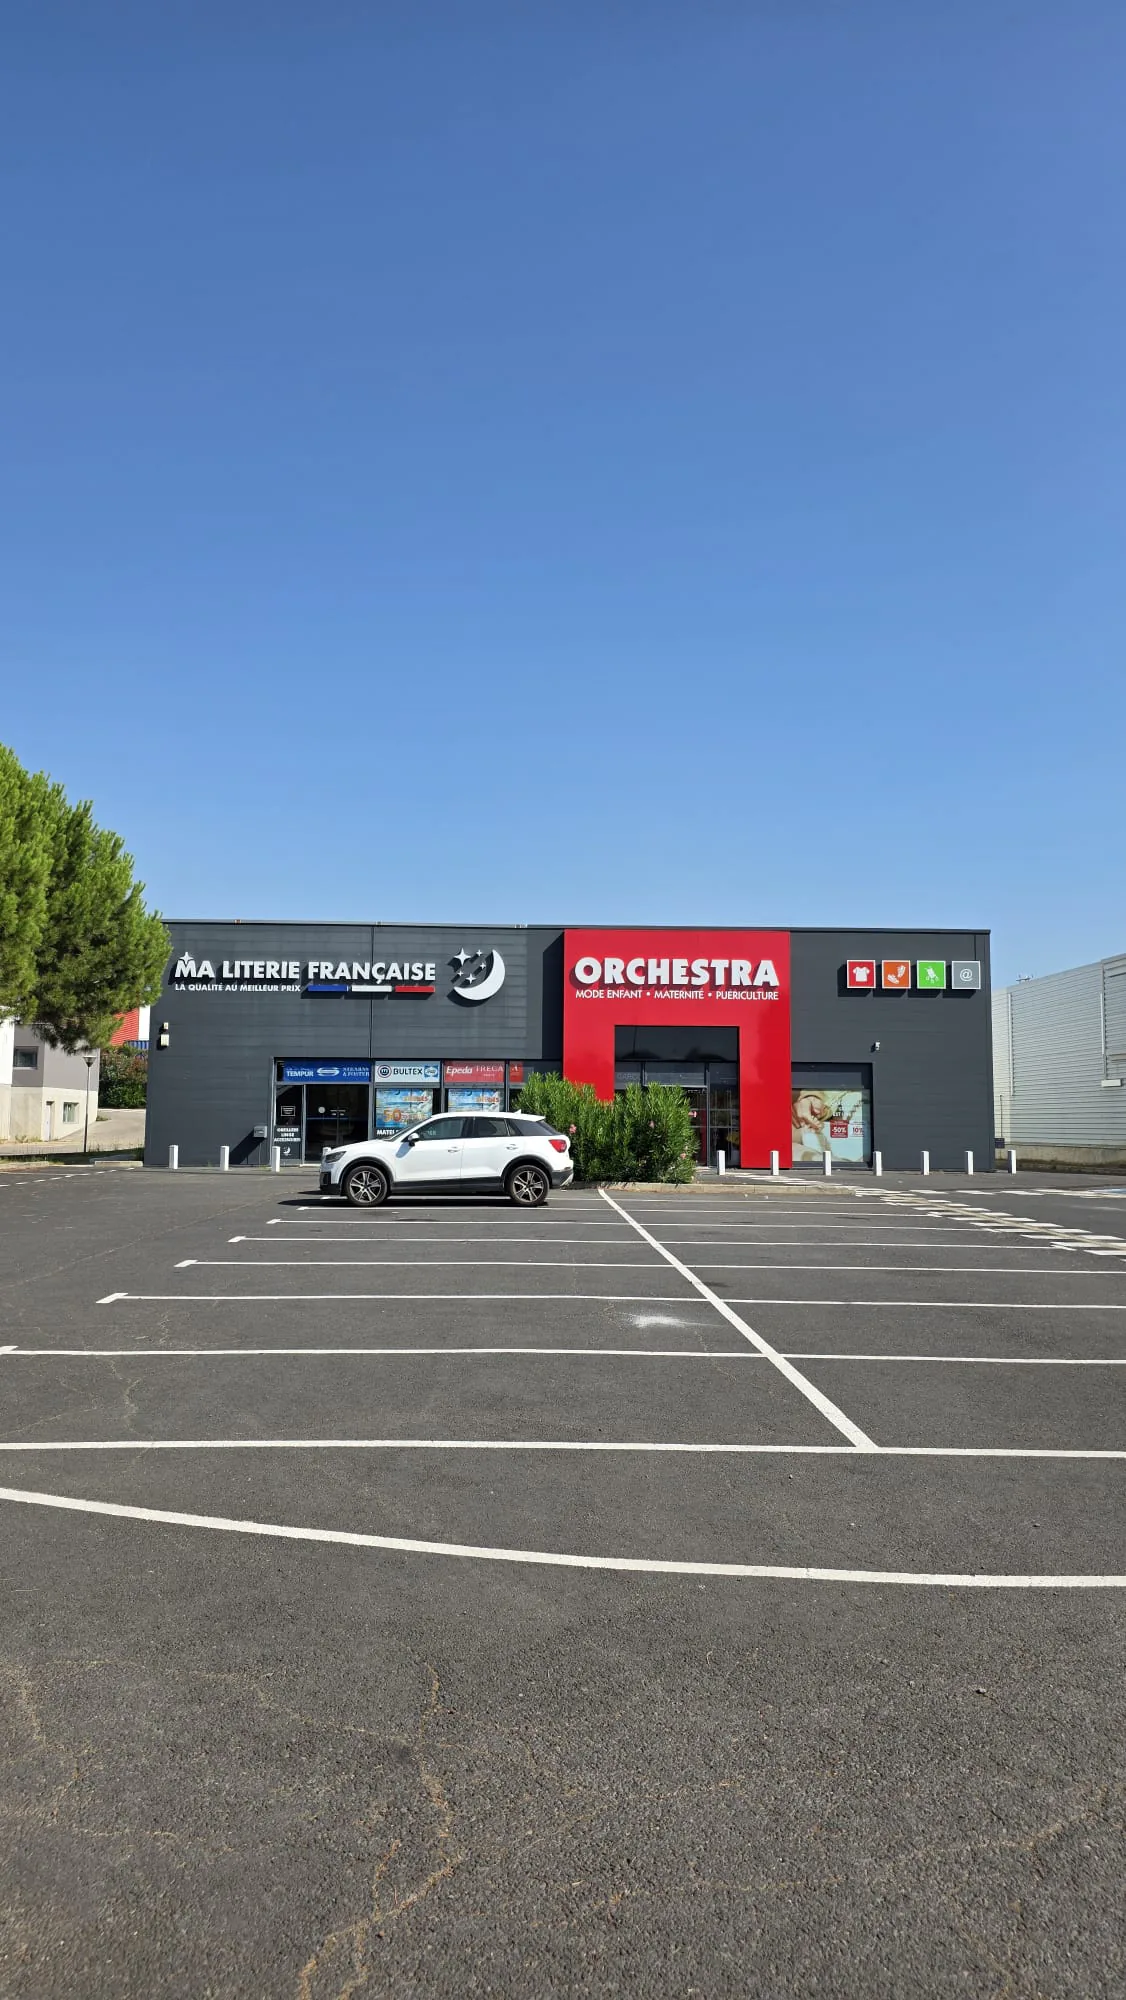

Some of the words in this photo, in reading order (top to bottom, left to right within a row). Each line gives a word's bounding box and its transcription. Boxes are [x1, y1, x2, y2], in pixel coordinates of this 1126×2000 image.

[174, 958, 216, 978] MA
[222, 960, 300, 979] LITERIE
[307, 961, 436, 984] FRANÇAISE
[574, 957, 780, 987] ORCHESTRA
[175, 983, 186, 991] LA
[188, 982, 223, 992] QUALITÉ
[225, 984, 238, 992] AU
[239, 984, 279, 992] MEILLEUR
[281, 984, 301, 992] PRIX
[575, 989, 605, 999] MODE
[607, 989, 643, 999] ENFANT
[393, 1067, 423, 1075] BULTEX
[446, 1065, 473, 1077] Epeda
